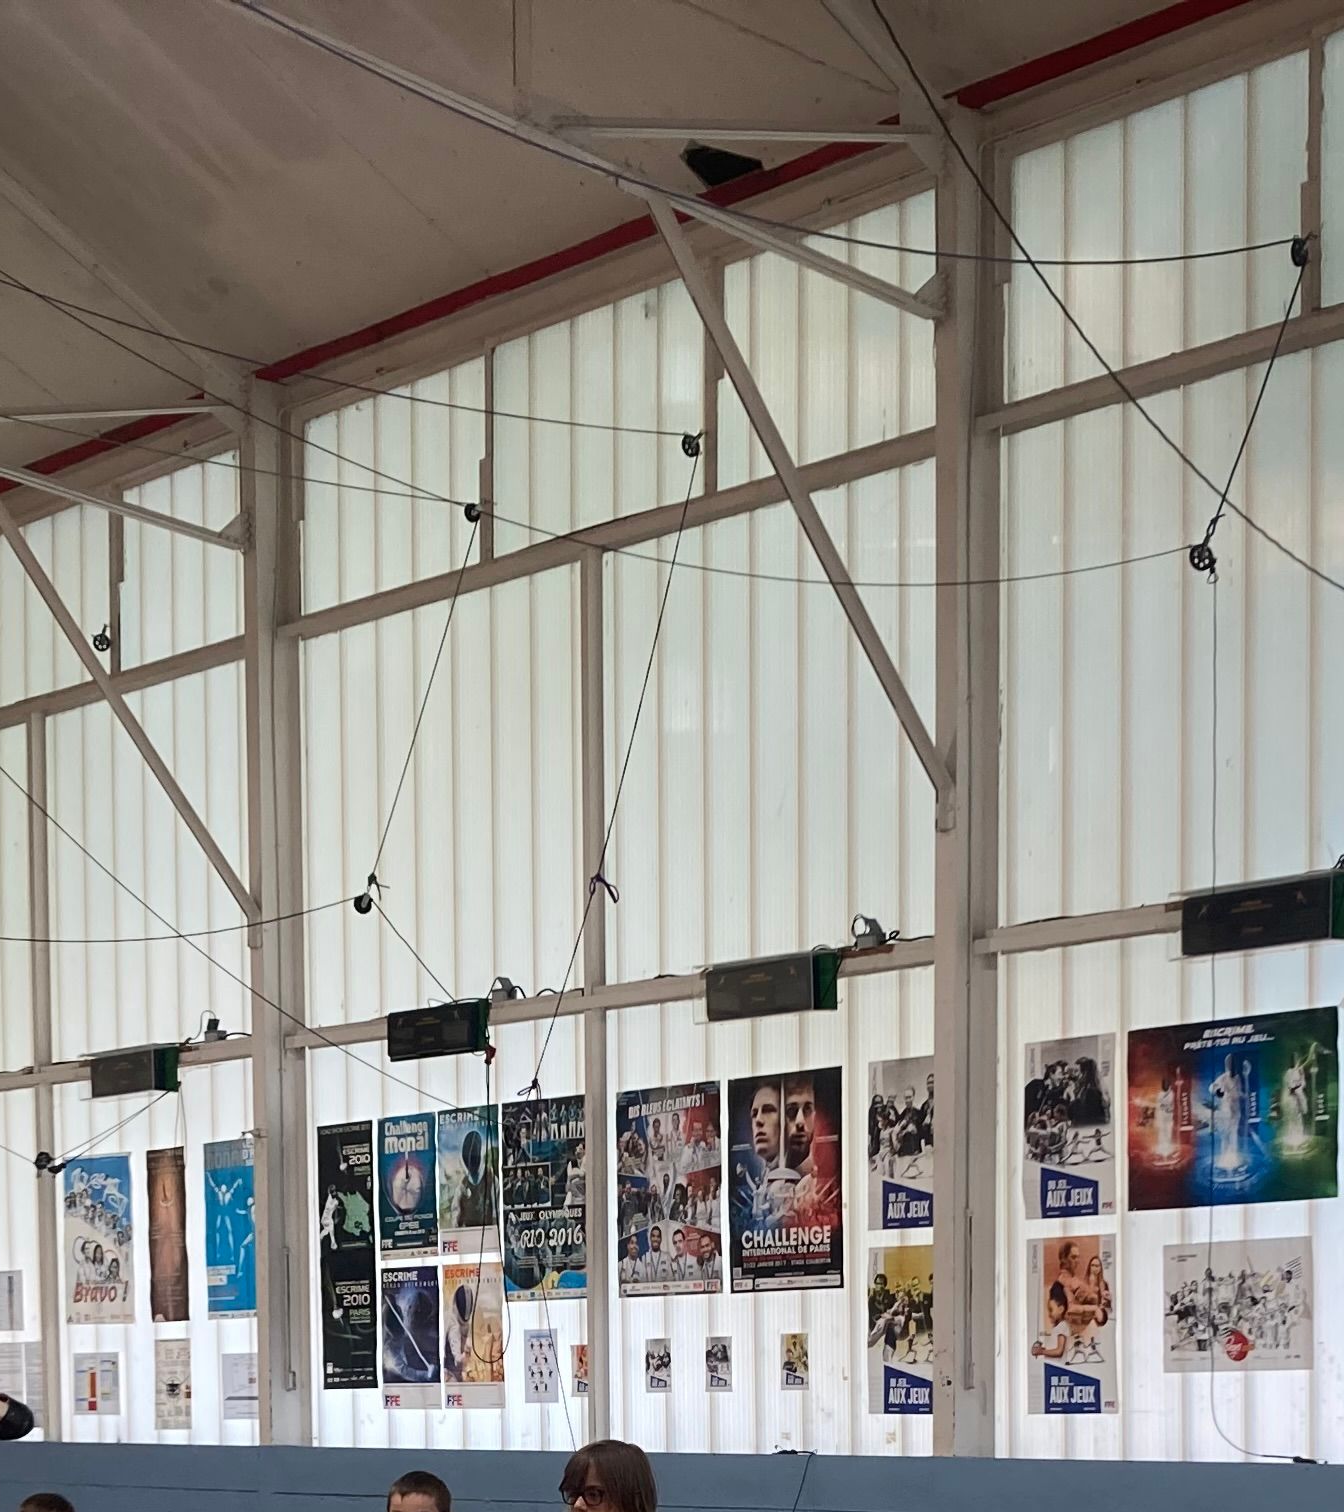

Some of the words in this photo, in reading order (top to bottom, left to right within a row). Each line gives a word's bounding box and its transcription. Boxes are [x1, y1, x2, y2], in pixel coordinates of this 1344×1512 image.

[439, 1109, 480, 1126] ESCRIME
[348, 1153, 371, 1165] 2010
[1046, 1189, 1067, 1208] AUX
[1067, 1187, 1093, 1207] JEUX
[538, 1207, 583, 1220] OLYMPIQUES
[887, 1202, 906, 1219] AUX
[907, 1200, 930, 1218] JEUX
[520, 1228, 545, 1249] RIO
[548, 1224, 584, 1247] 2016
[741, 1224, 832, 1249] CHALLENGE
[442, 1240, 459, 1253] FFE
[741, 1246, 797, 1257] INTERNATIONAL
[797, 1244, 808, 1254] DE
[809, 1243, 831, 1253] PARIS
[383, 1271, 419, 1283] ESCRIME
[72, 1280, 117, 1303] Bravo
[121, 1279, 130, 1303] !
[336, 1284, 370, 1295] ESCRIME
[343, 1293, 371, 1307] 2010
[348, 1308, 371, 1317] PARIS
[384, 1395, 401, 1407] FFE
[446, 1394, 463, 1407] FFE
[888, 1387, 907, 1405] AUX
[907, 1387, 930, 1405] JEUX
[1049, 1385, 1070, 1404] AUX
[1070, 1385, 1096, 1404] JEUX
